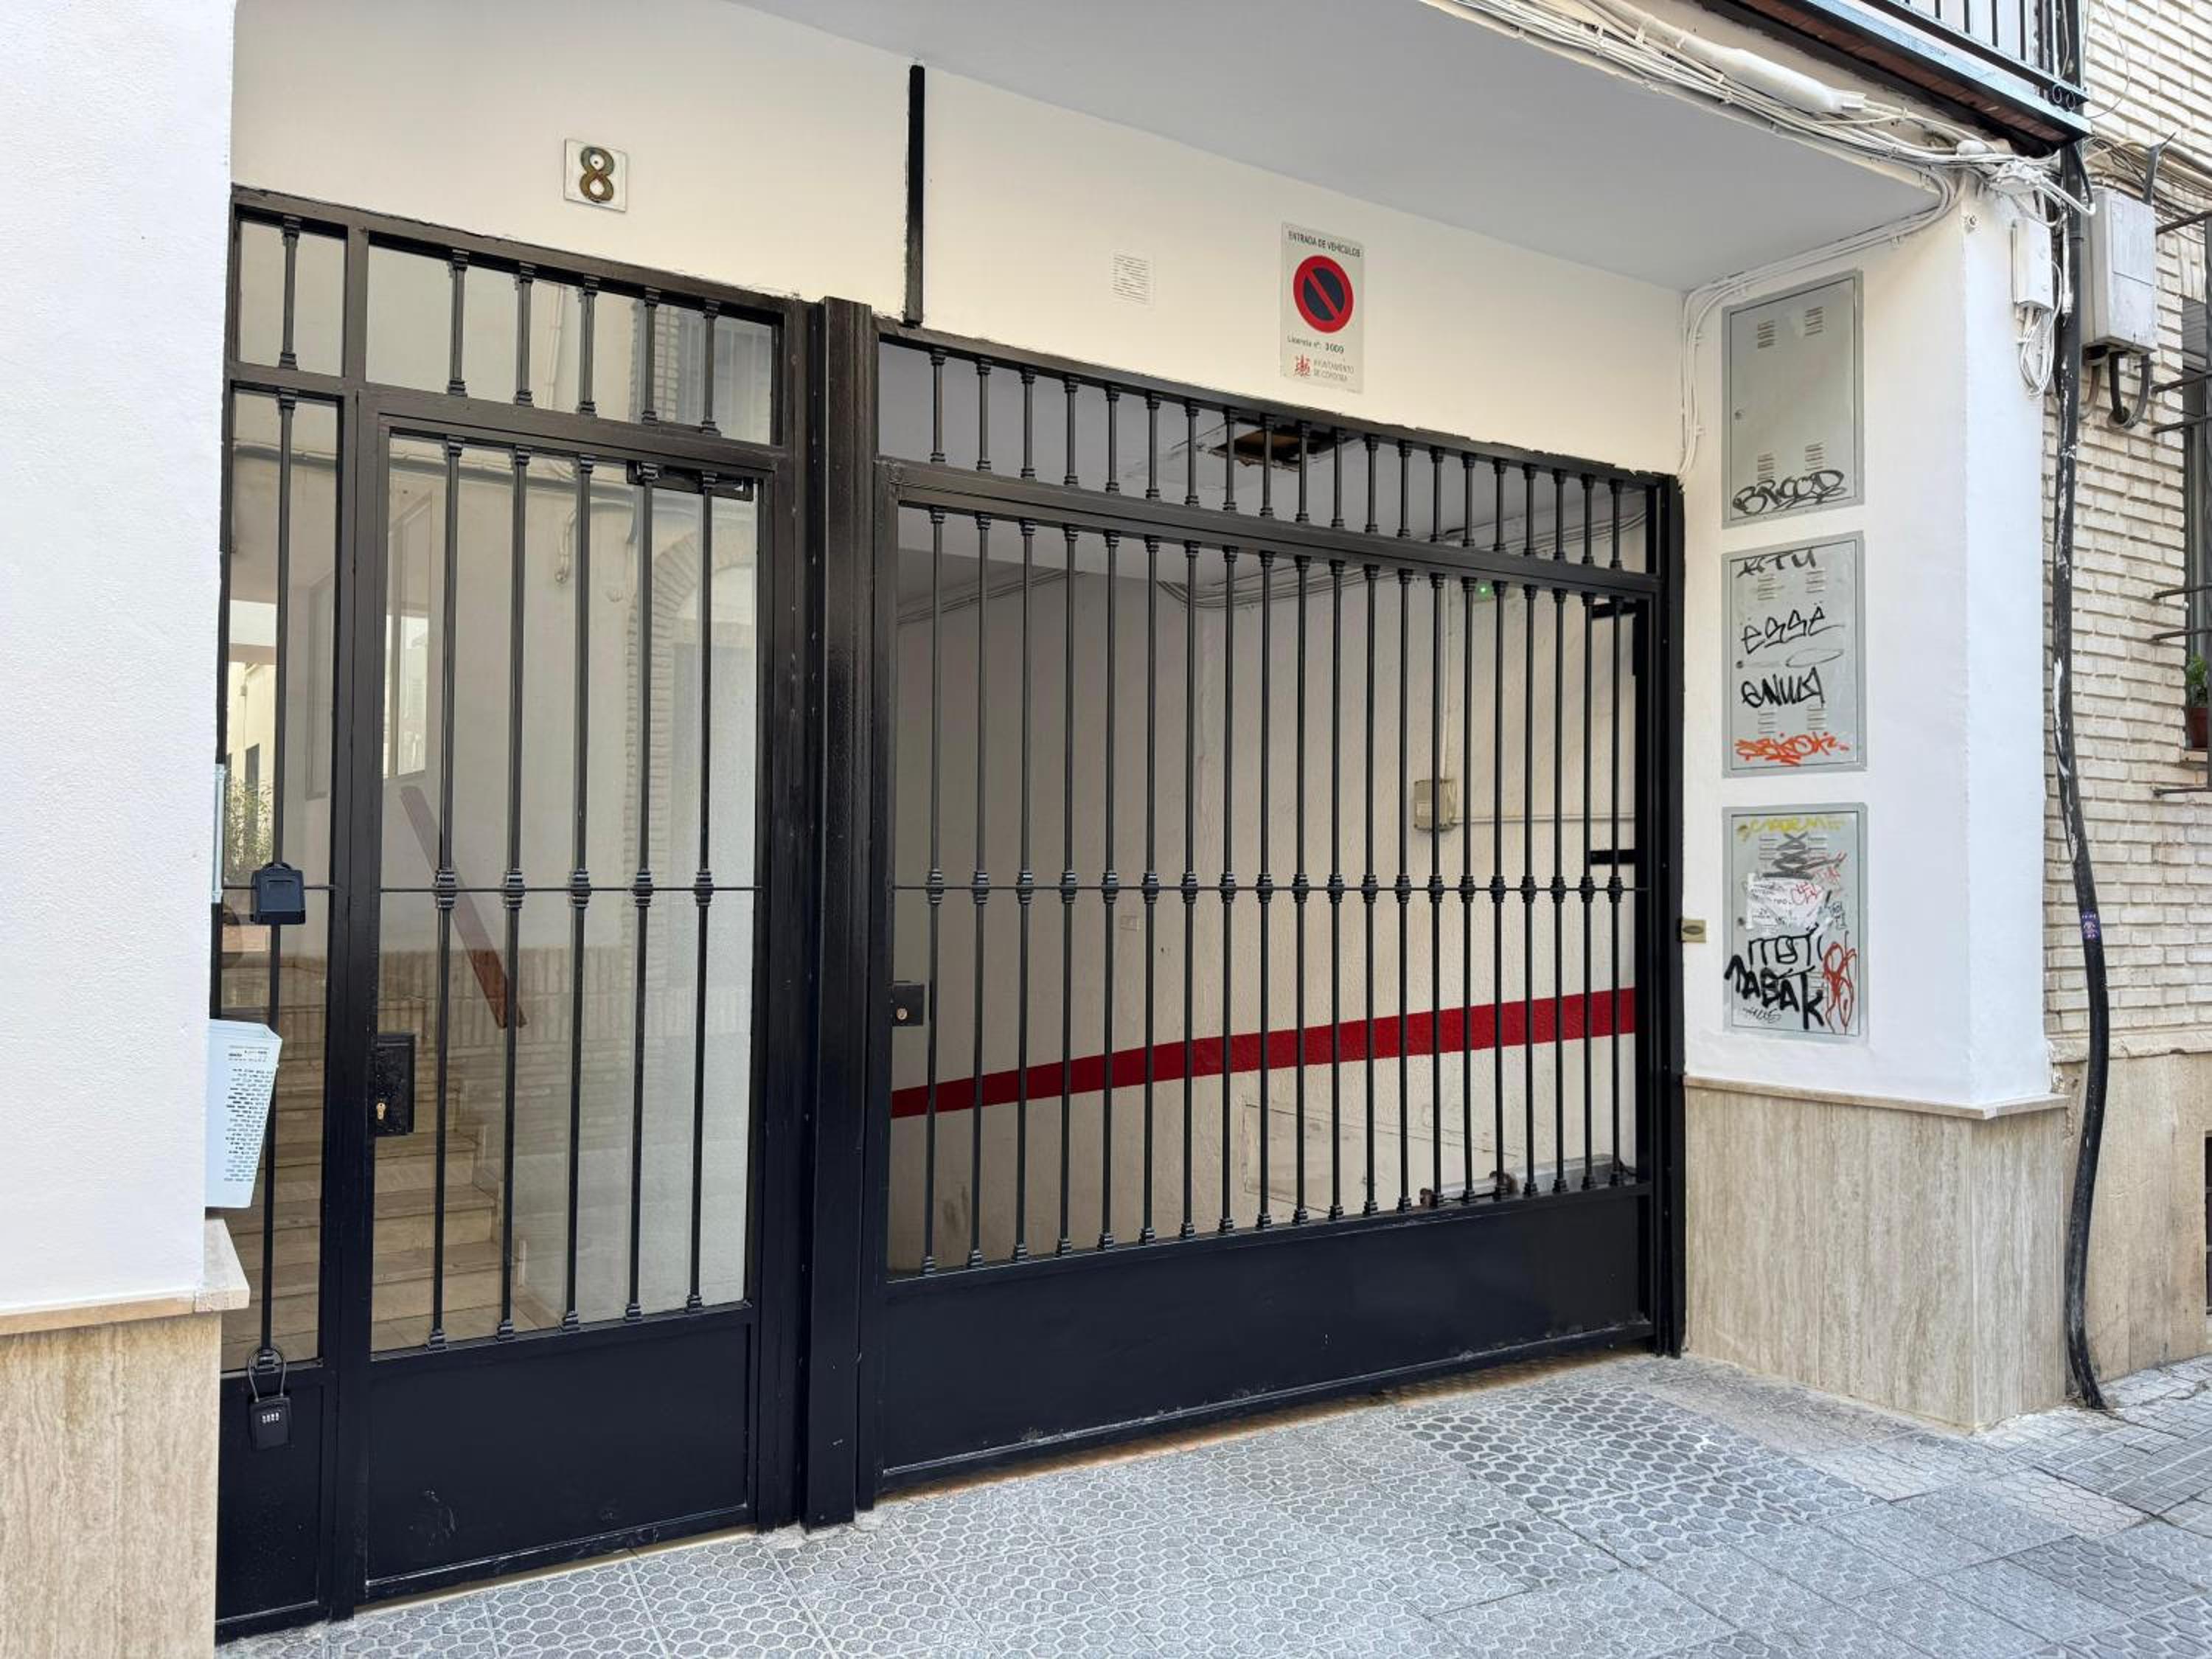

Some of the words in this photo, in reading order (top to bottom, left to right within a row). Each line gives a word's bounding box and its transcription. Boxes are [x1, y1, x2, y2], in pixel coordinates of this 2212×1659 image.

[580, 147, 615, 203] 8
[1287, 230, 1317, 246] ENTRADA
[1318, 239, 1326, 249] DE
